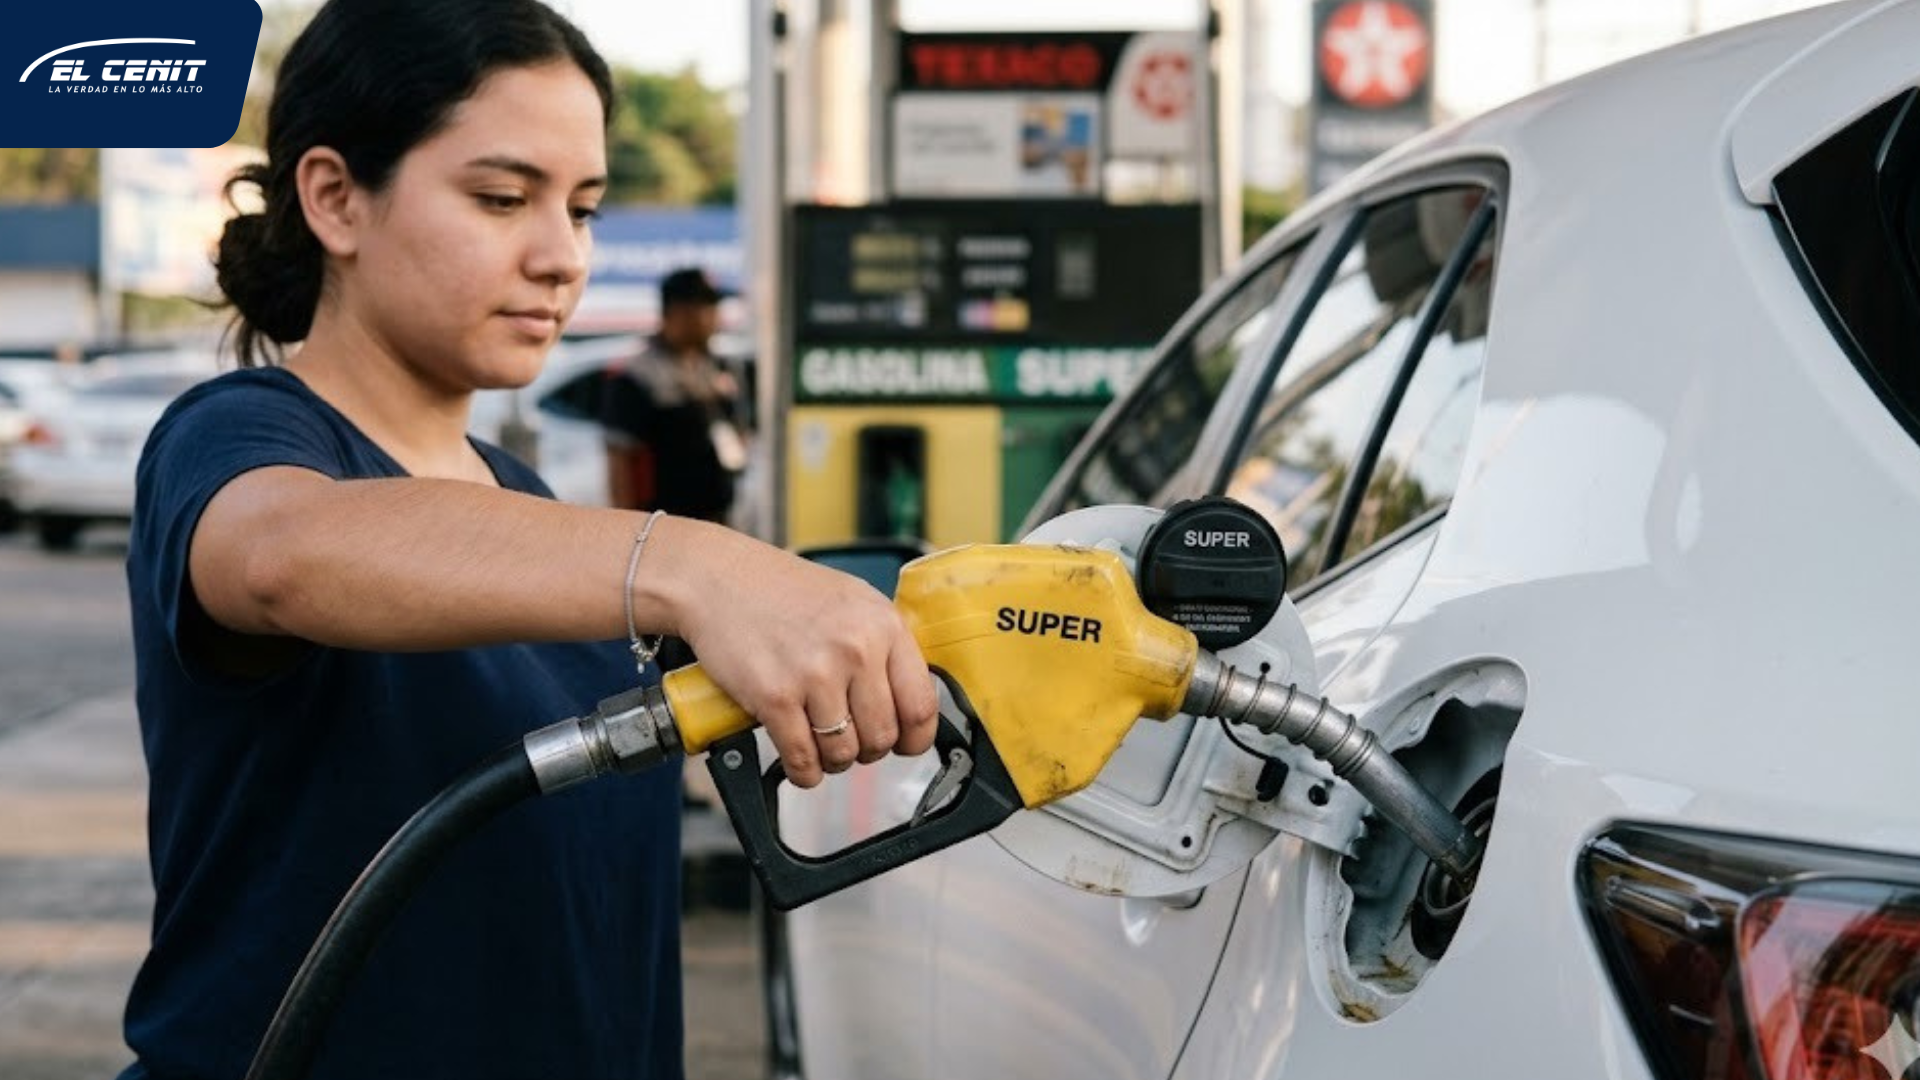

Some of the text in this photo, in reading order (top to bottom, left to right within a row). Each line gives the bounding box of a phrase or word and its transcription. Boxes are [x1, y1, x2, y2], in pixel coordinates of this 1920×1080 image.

[801, 348, 990, 396] GASOLINA
[1184, 529, 1250, 548] SUPER
[996, 607, 1102, 643] SUPER
